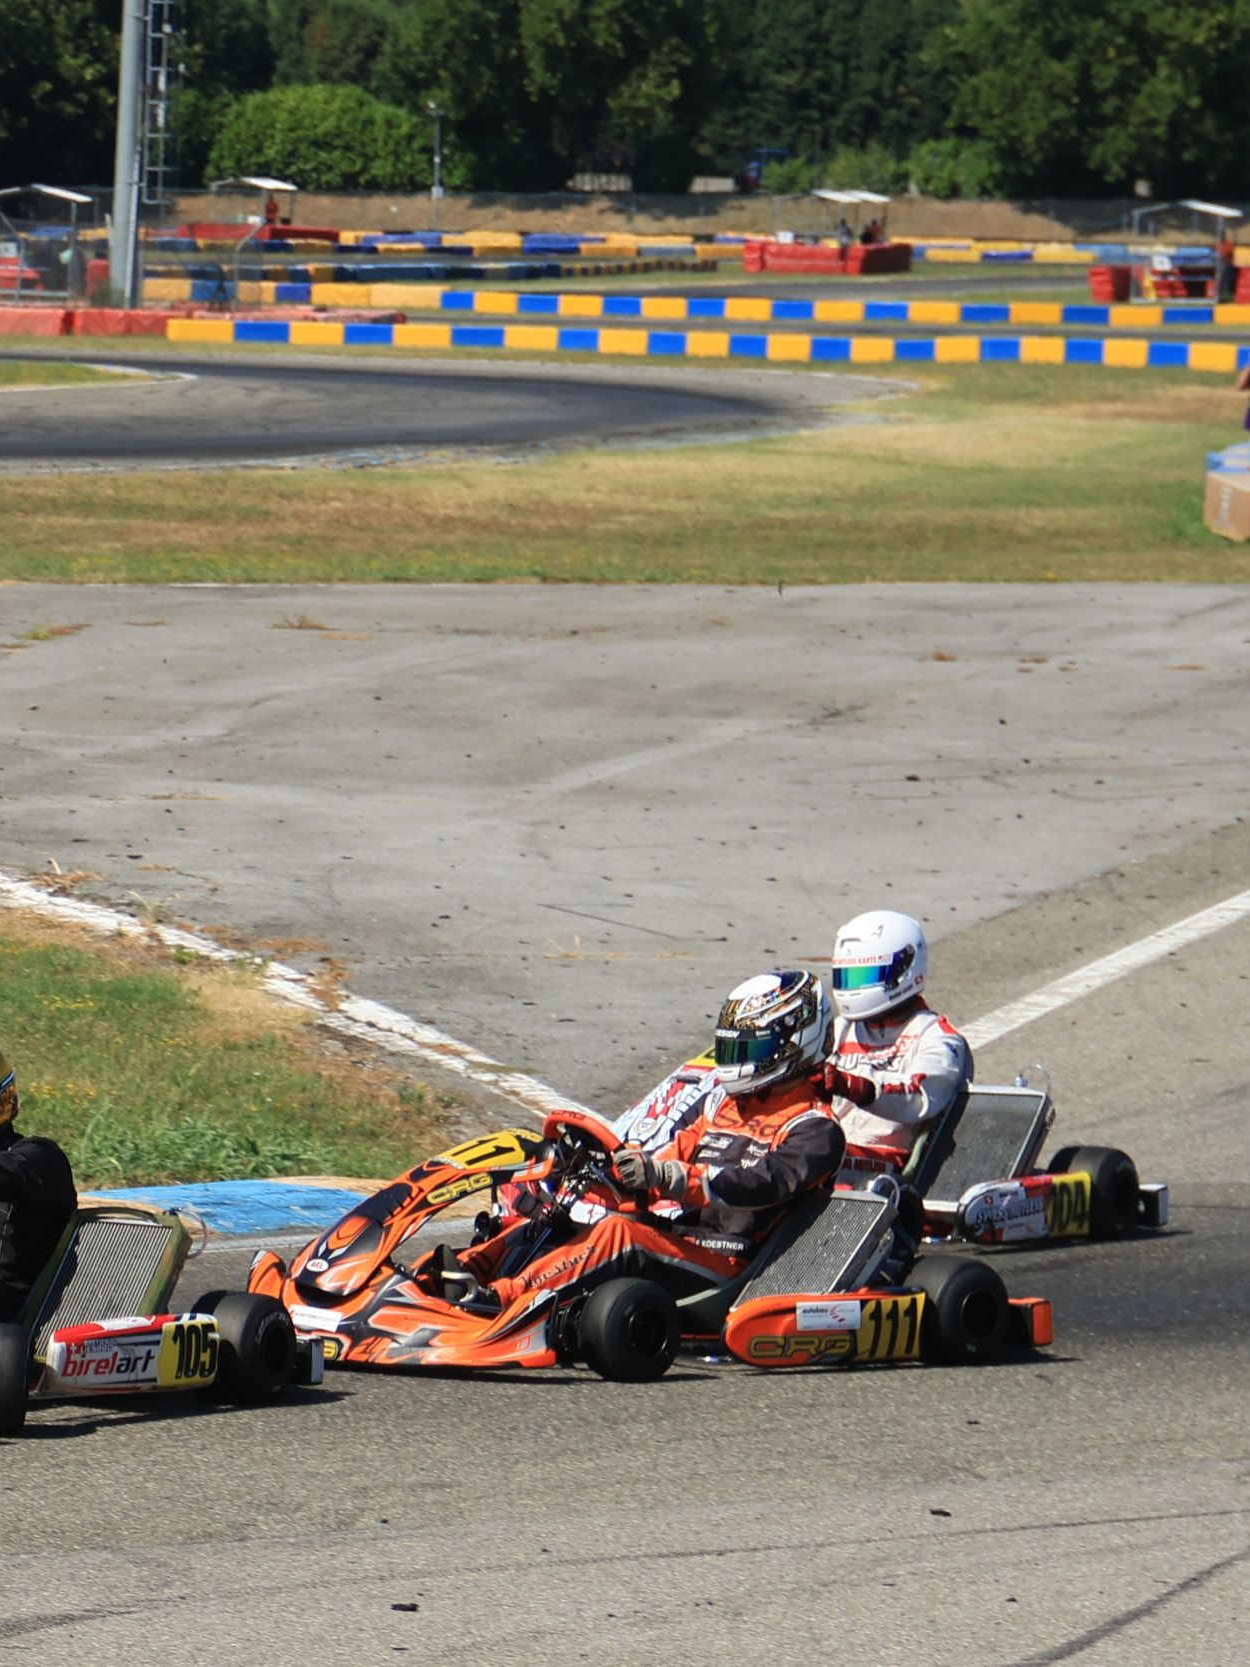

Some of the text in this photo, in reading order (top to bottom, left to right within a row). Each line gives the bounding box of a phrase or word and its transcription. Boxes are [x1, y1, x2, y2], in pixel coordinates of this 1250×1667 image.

[426, 1172, 494, 1204] CRG
[701, 1240, 744, 1251] KOESTNER
[869, 1297, 918, 1358] 111
[172, 1323, 218, 1380] 105
[749, 1335, 850, 1358] CRG
[62, 1349, 156, 1377] birelart
